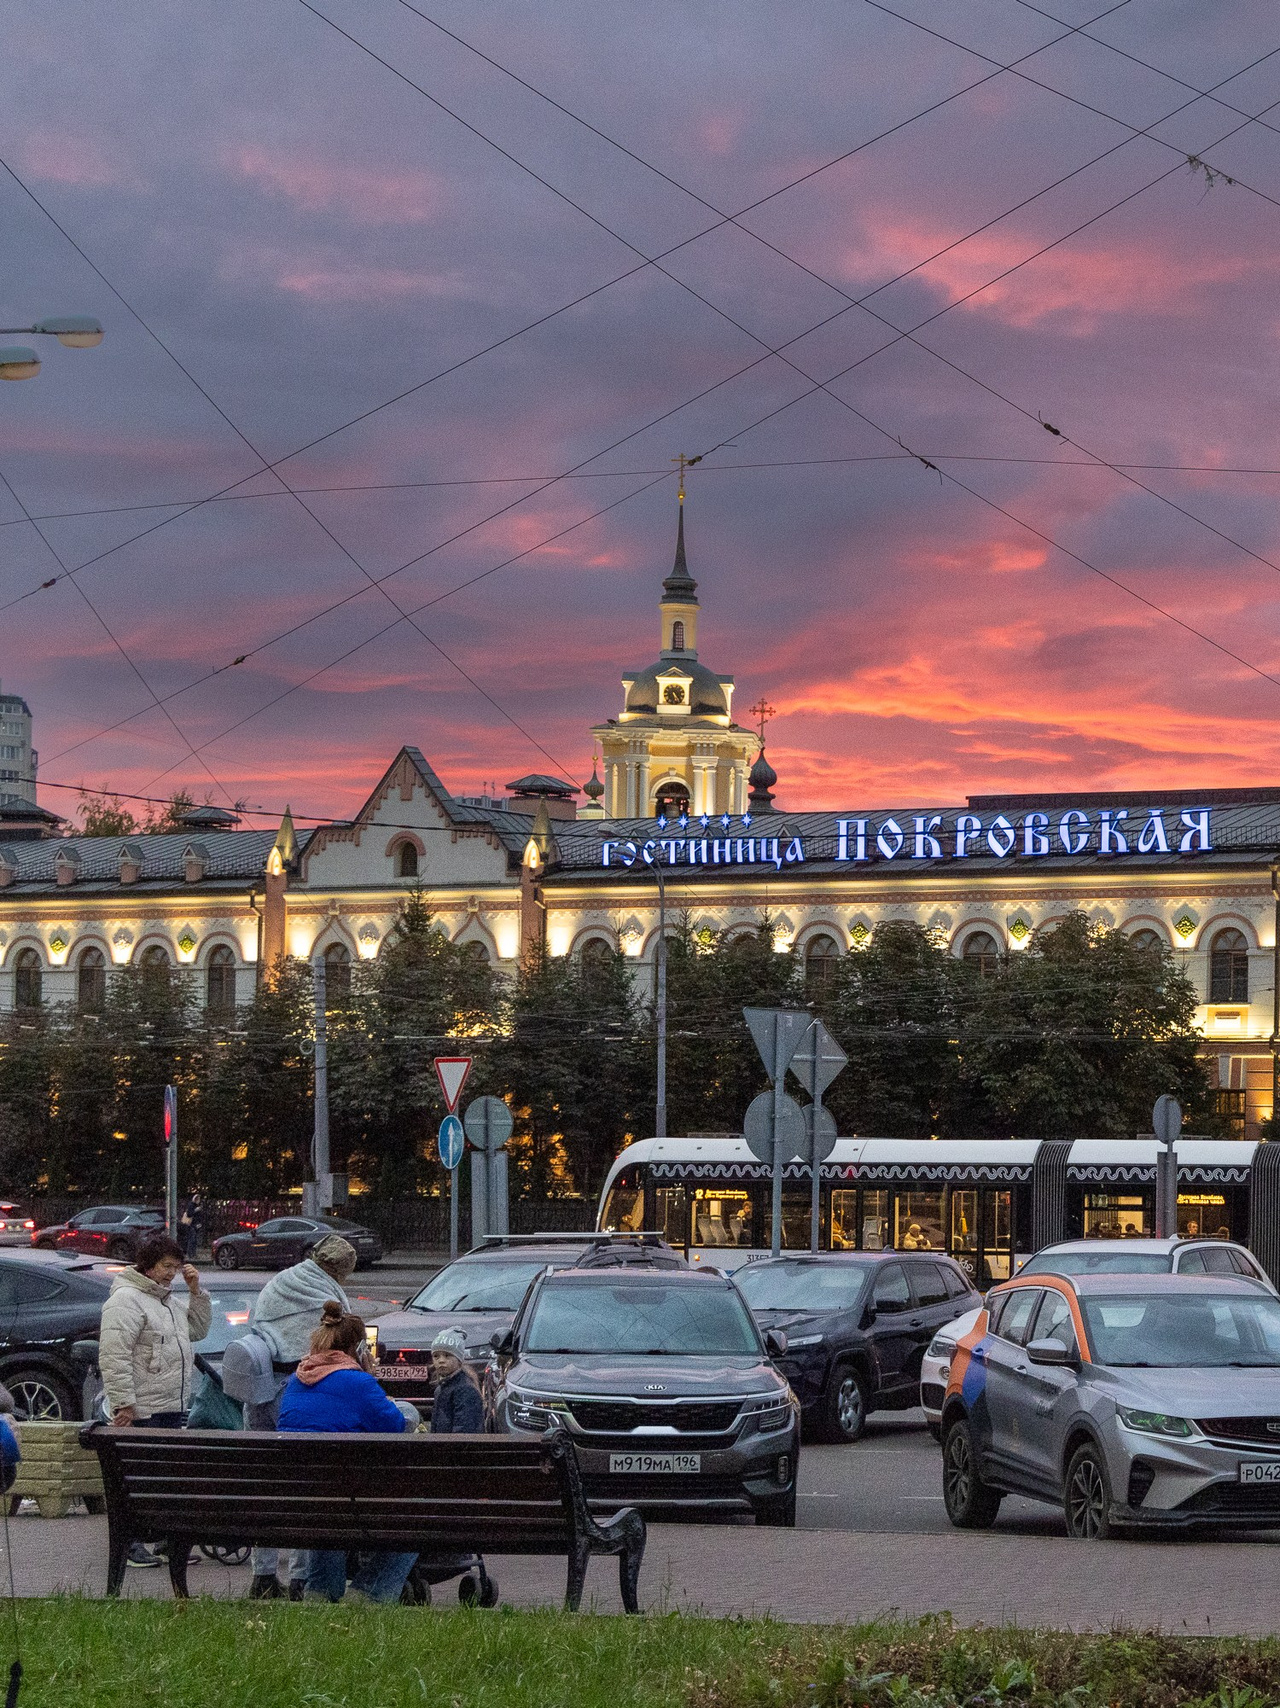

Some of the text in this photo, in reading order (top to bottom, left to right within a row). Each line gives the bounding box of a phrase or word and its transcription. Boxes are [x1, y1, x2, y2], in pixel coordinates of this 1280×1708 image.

[834, 807, 1213, 861] ПОКРОВСКАЯ
[613, 1456, 697, 1471] М919МА 196
